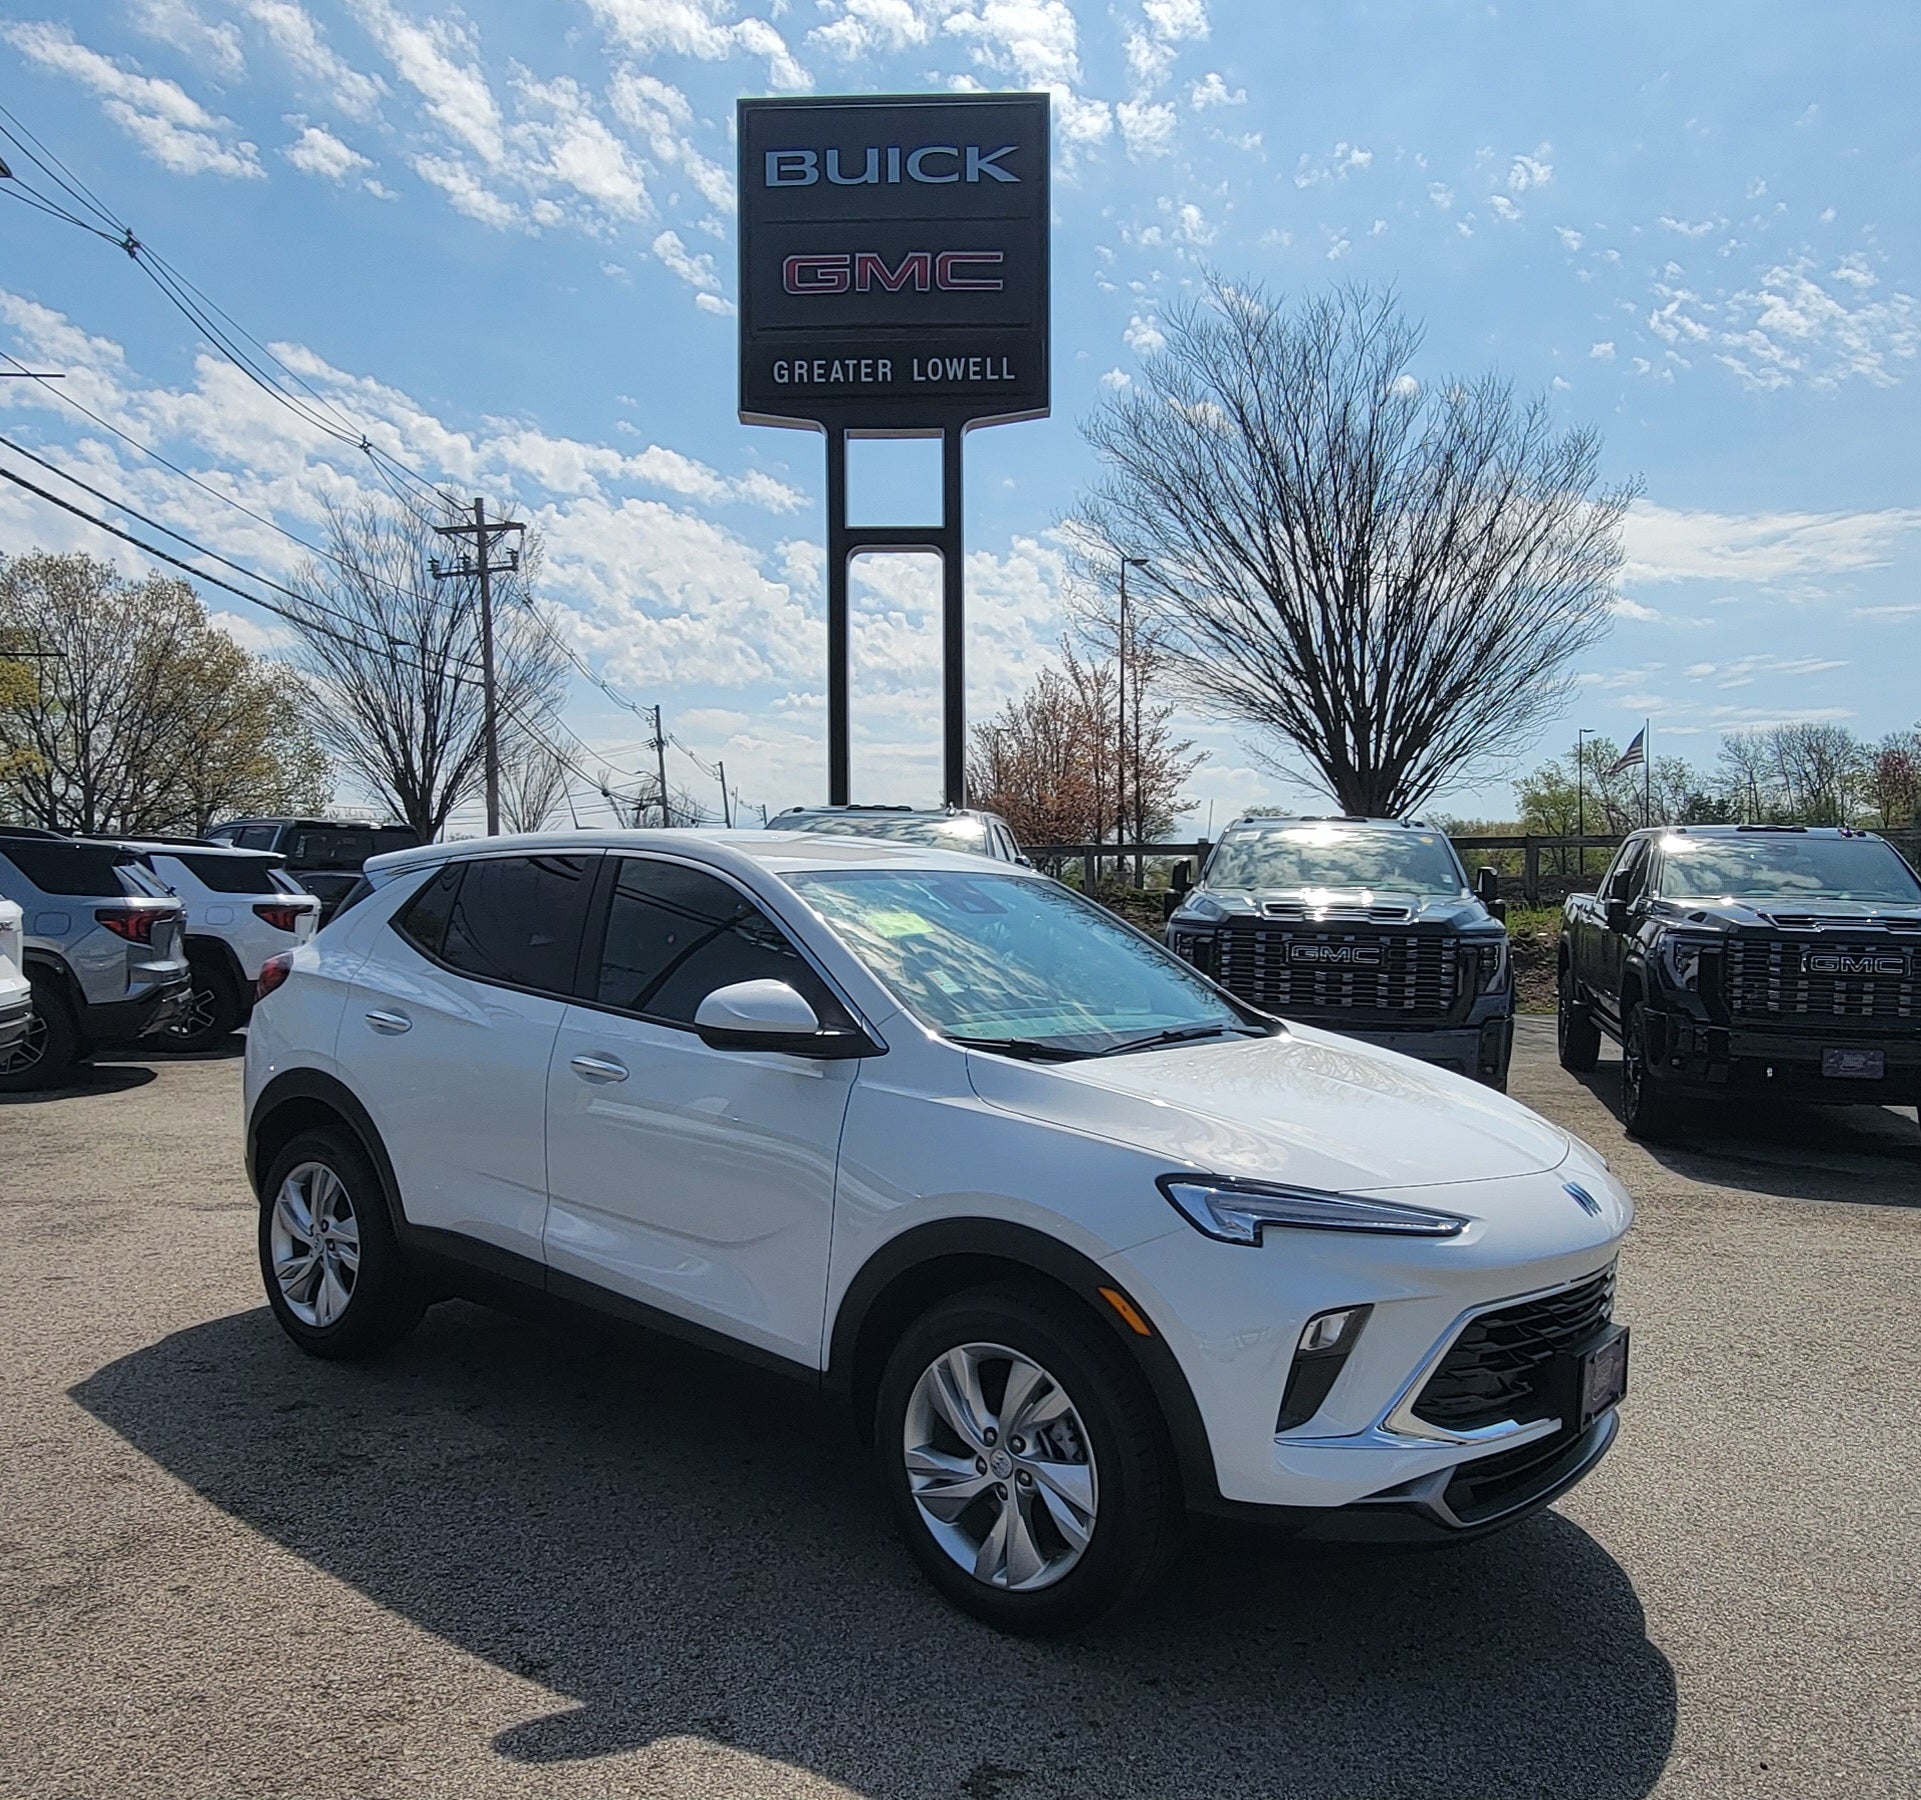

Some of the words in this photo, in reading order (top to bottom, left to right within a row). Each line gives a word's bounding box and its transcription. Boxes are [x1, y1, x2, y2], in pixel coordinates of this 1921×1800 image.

[765, 146, 1022, 187] BUICK
[783, 252, 1004, 294] GMC
[773, 359, 893, 384] GREATER
[913, 357, 1016, 382] LOWELL
[1291, 945, 1380, 964] GMC
[1810, 955, 1904, 975] GMC
